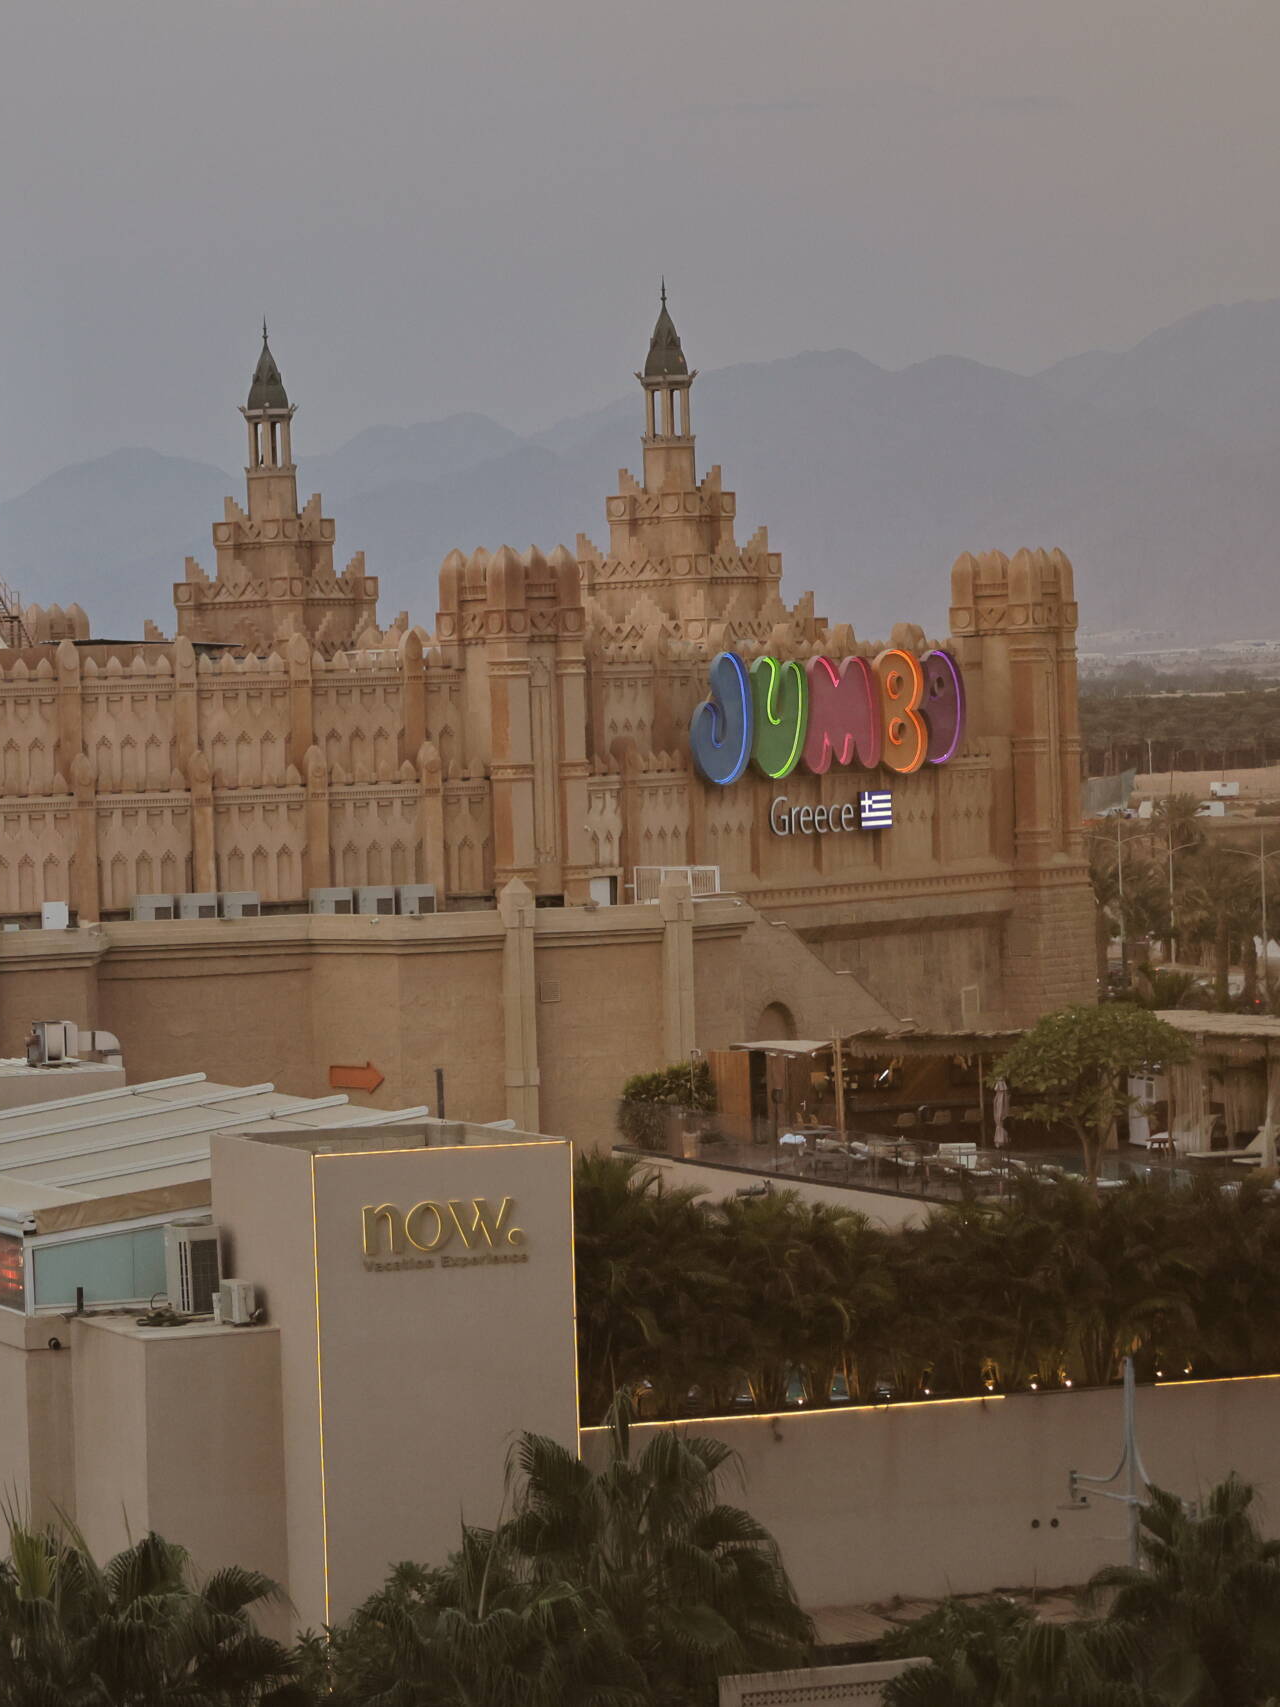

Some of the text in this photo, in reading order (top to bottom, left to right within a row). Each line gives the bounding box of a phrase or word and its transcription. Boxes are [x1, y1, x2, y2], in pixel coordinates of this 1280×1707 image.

[691, 648, 966, 785] JUMBO
[770, 796, 854, 837] Greece
[363, 1252, 529, 1272] Vacation Experience
